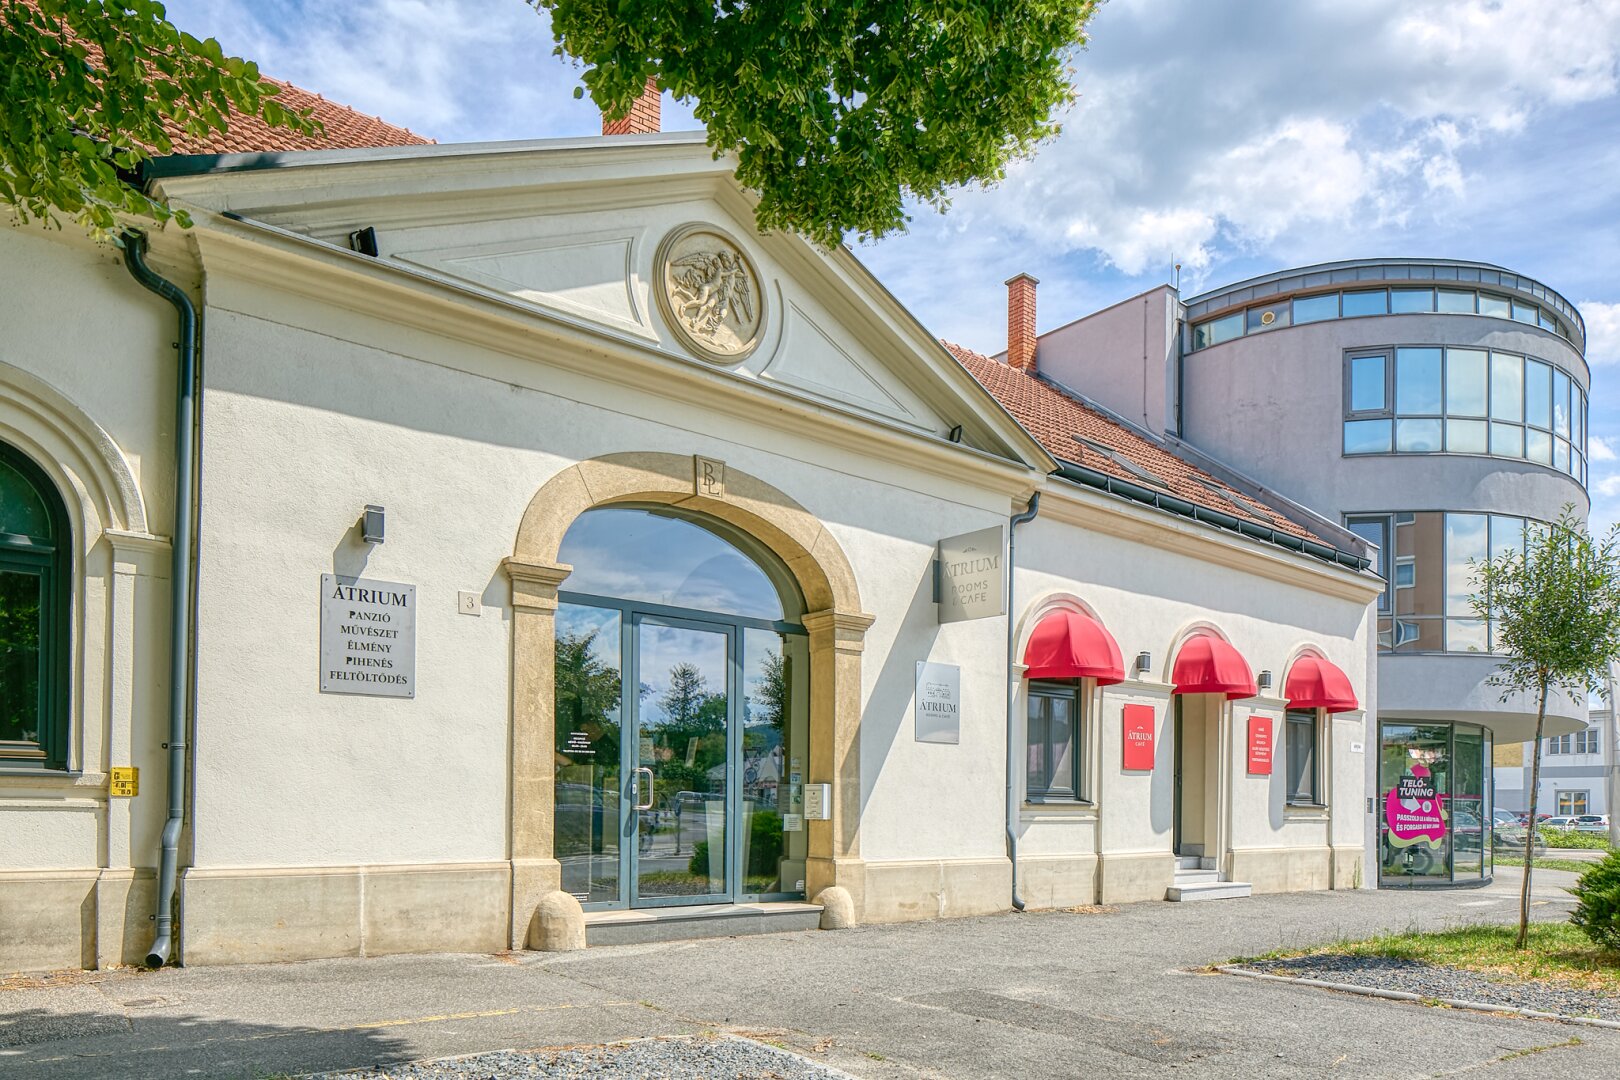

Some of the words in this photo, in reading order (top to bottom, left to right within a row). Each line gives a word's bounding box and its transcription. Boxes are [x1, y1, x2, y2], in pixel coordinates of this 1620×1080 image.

[943, 555, 999, 578] ÁTRIUM
[951, 580, 988, 594] ROOMS
[332, 583, 407, 607] ÁTRIUM
[960, 592, 987, 605] CAFE
[466, 596, 474, 609] 3
[349, 611, 391, 623] PANZIÓ
[340, 625, 399, 639] MŰVÉSZET
[347, 640, 392, 653] ÉLMÉNY
[346, 657, 393, 669] PIHENÉS
[329, 670, 408, 685] FELTÖLTŐDÉS
[920, 698, 956, 713] ÁTRIUM
[1127, 729, 1152, 741] ÁTRIUM
[1402, 777, 1427, 788] TELÓ-
[1400, 787, 1434, 797] TUNING
[1396, 823, 1403, 831] ÉS
